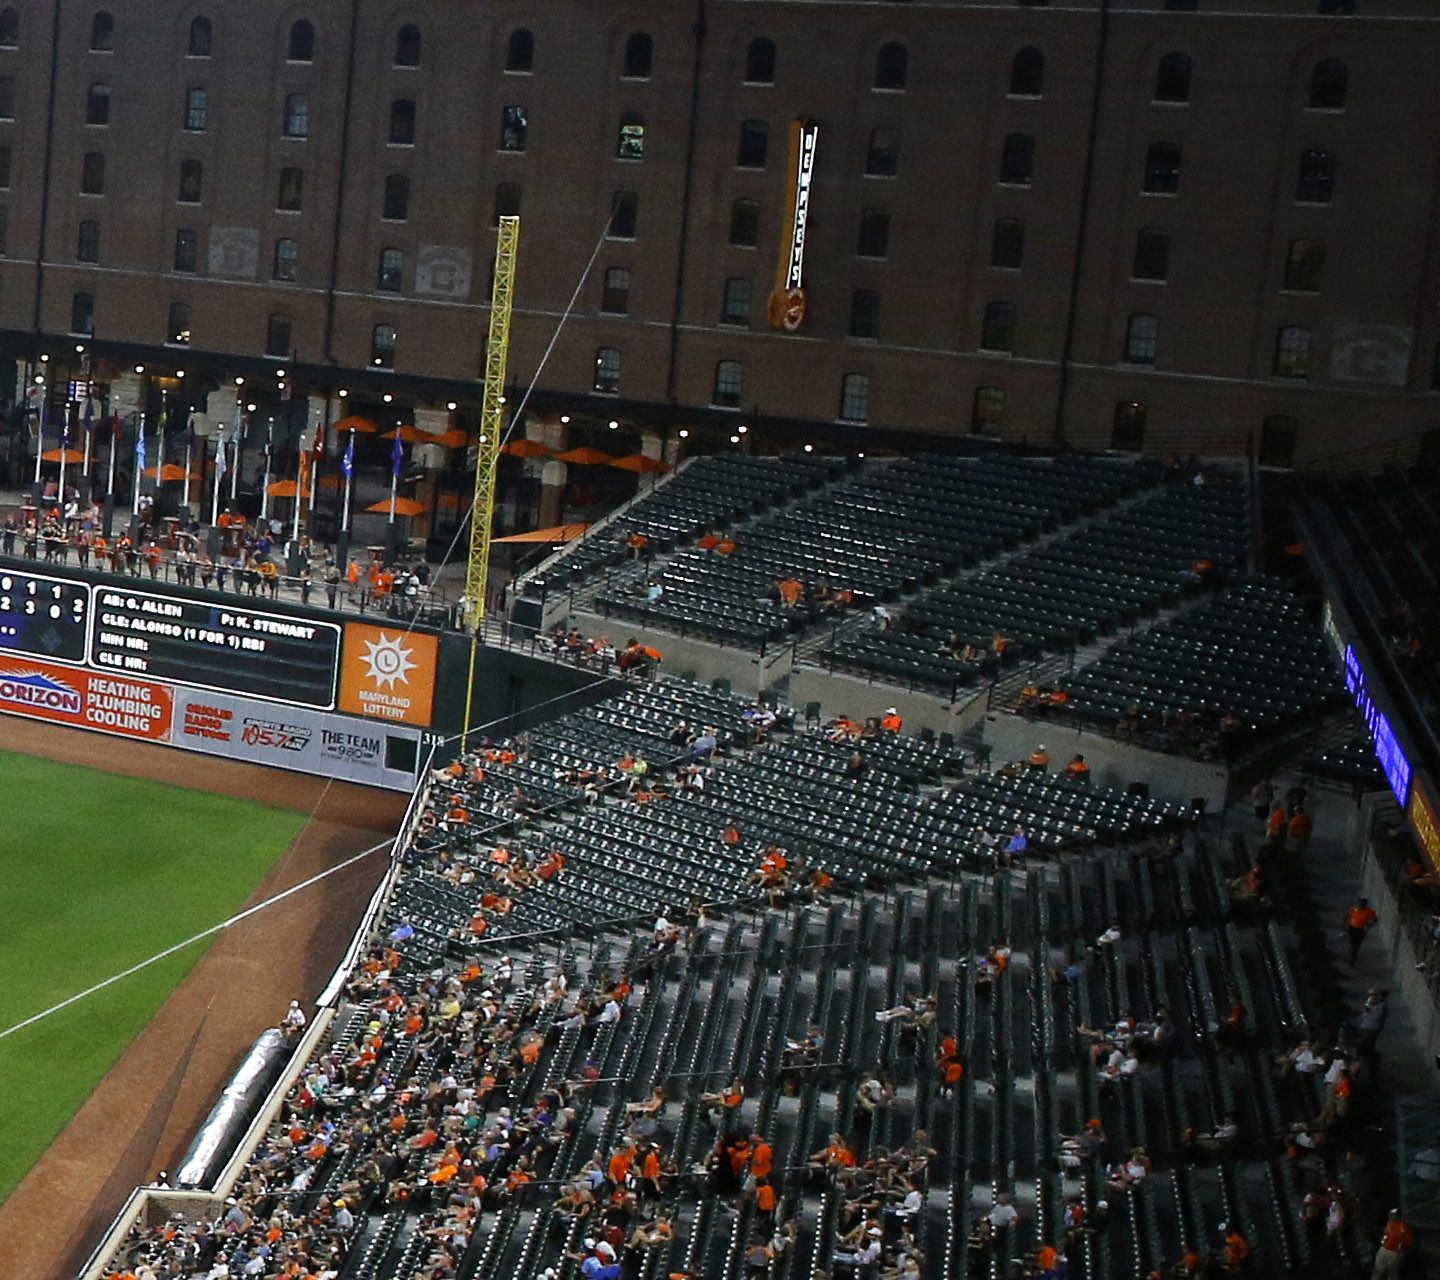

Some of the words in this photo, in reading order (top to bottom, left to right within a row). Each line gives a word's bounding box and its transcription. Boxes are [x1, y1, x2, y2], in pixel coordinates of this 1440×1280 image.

[1, 576, 12, 590] 0
[27, 581, 36, 594] 1
[51, 585, 61, 598] 1
[0, 596, 10, 610] 2
[25, 600, 35, 614] 3
[50, 605, 59, 618] 0
[141, 600, 182, 617] ALLEN
[101, 613, 130, 629] CLE:
[130, 617, 181, 637] ALONSO
[198, 629, 225, 646] FOR
[221, 613, 235, 627] P:
[236, 616, 251, 630] K.
[252, 618, 317, 640] STEWART
[100, 632, 125, 648] MIN
[99, 651, 123, 666] CLE
[88, 677, 152, 701] HEATING
[87, 693, 162, 719] PLUMBING
[359, 690, 411, 709] MARYLAND
[86, 707, 150, 731] COOLING
[363, 702, 406, 718] LOTTERY
[185, 713, 222, 730] RADIO
[322, 729, 346, 744] THE
[346, 732, 380, 754] TEAM
[422, 732, 445, 748] 318
[337, 746, 363, 759] 980
